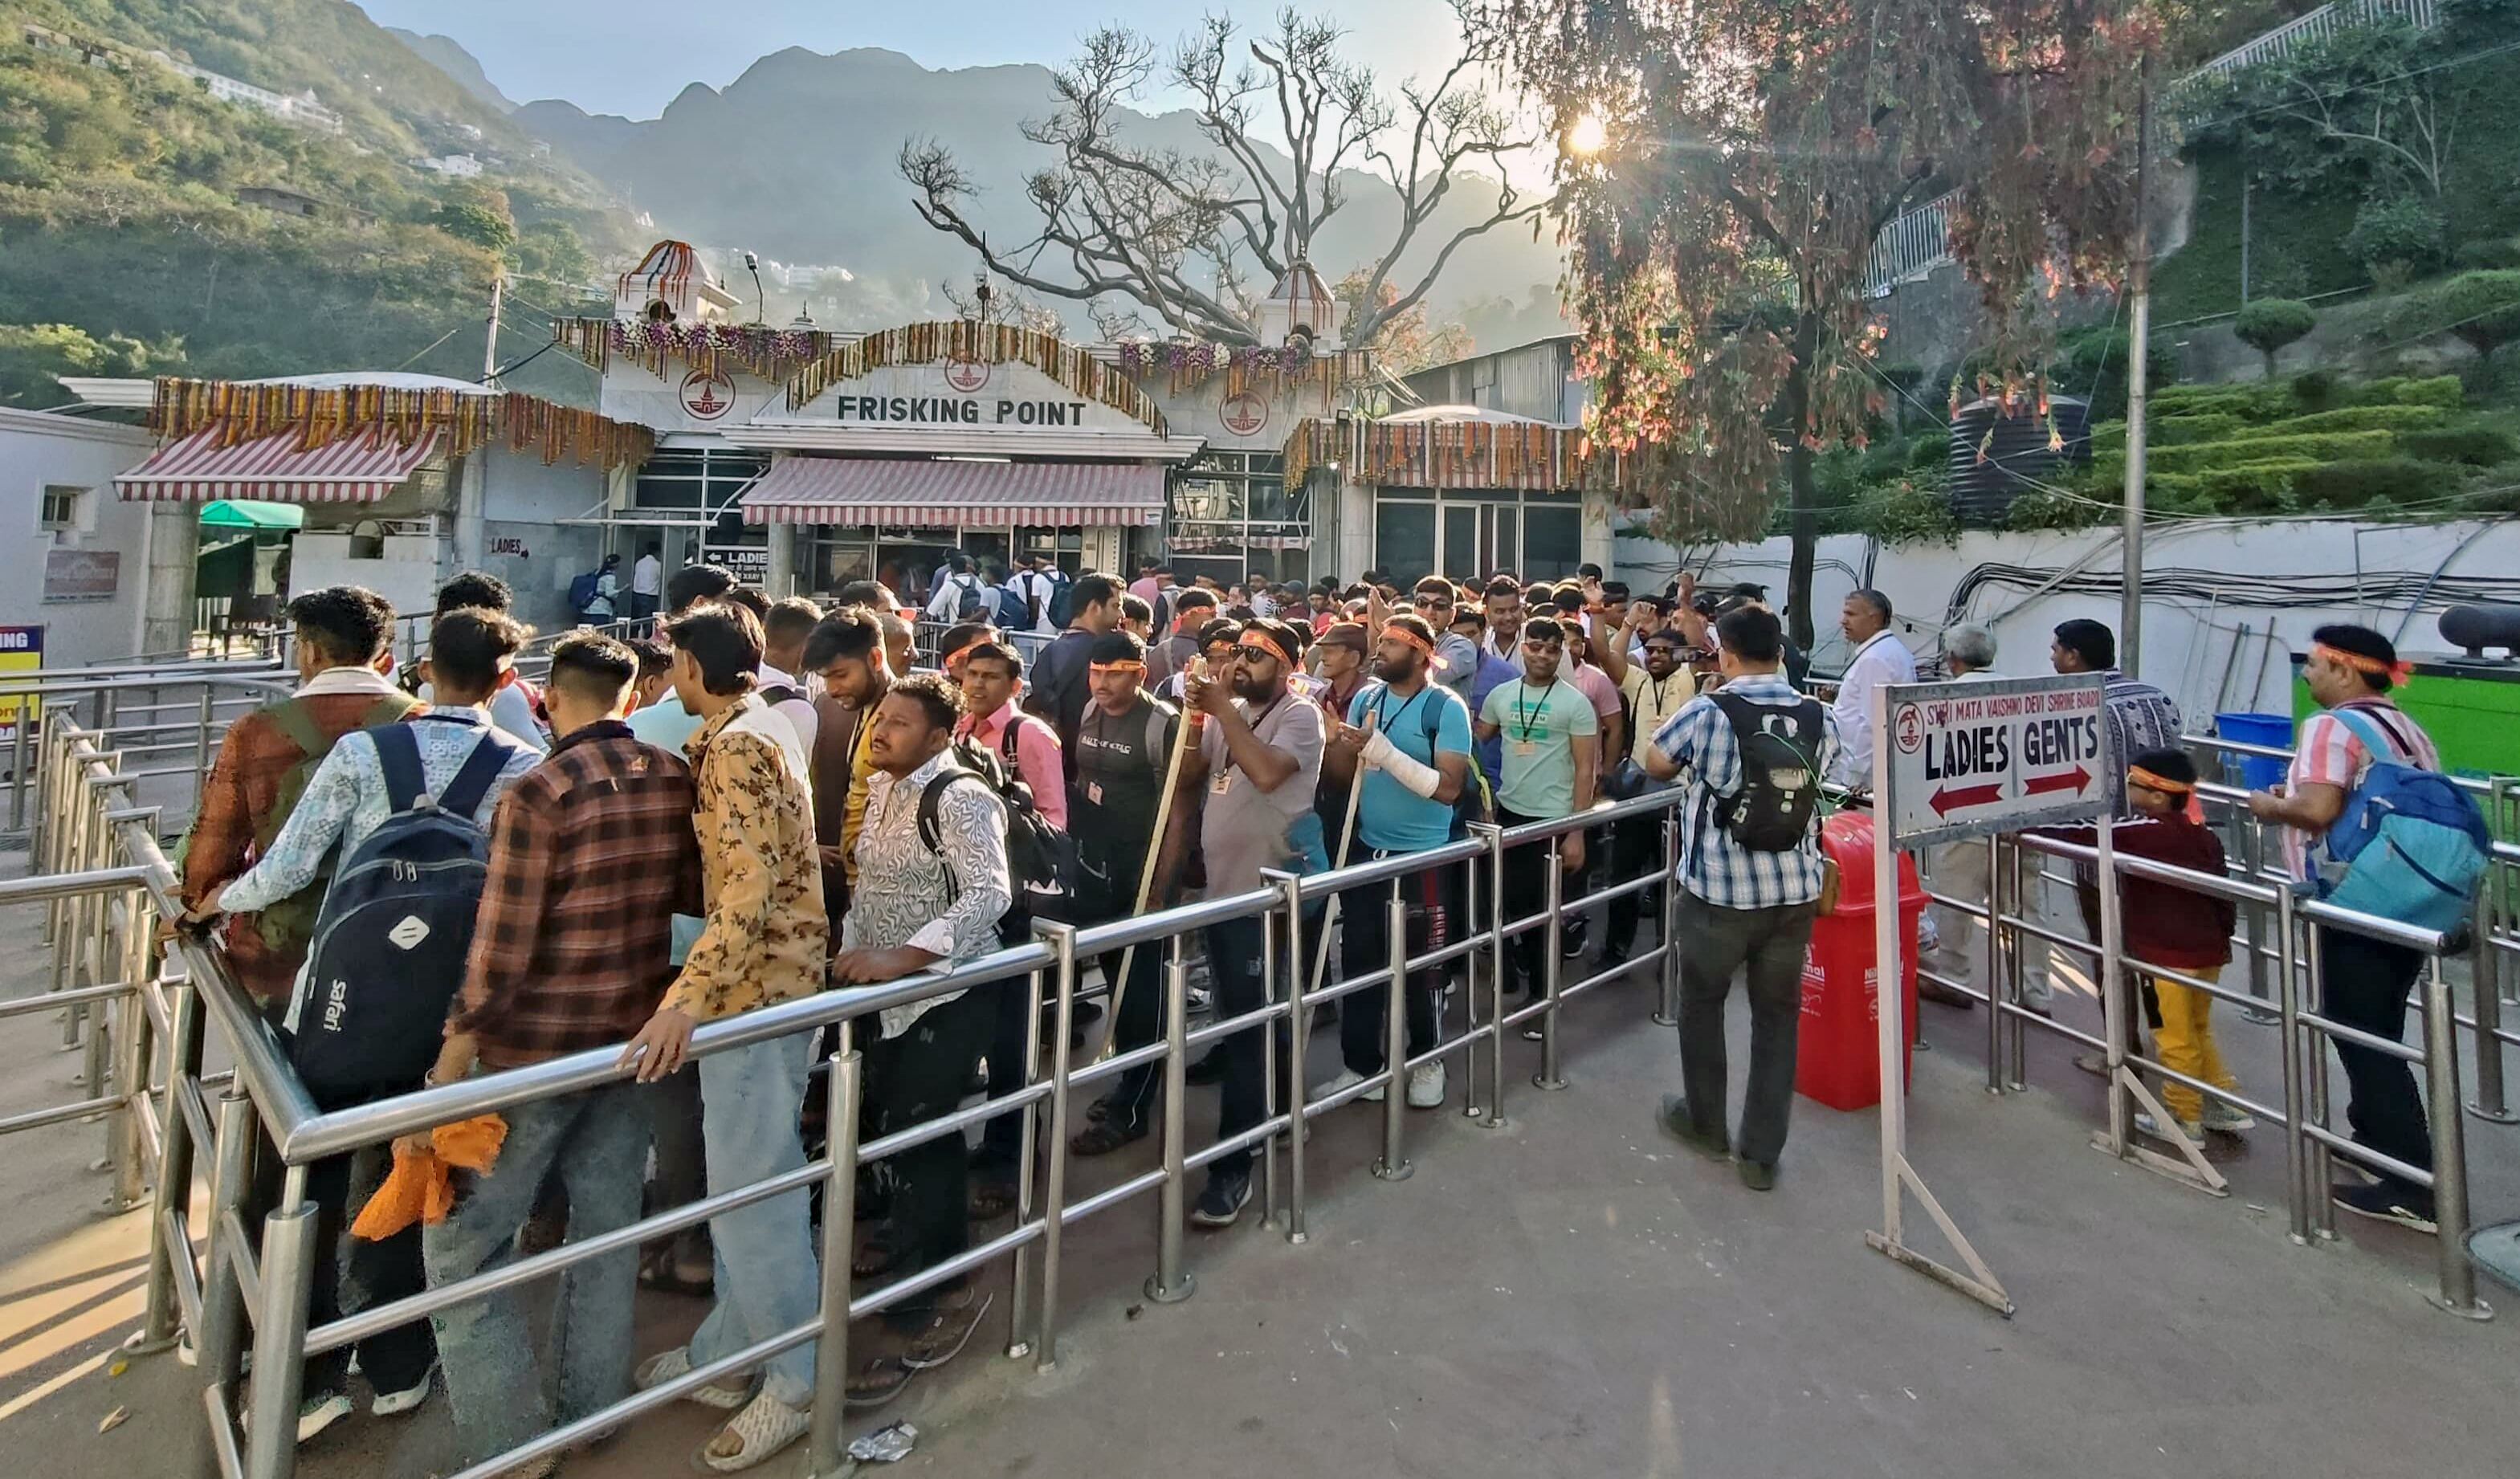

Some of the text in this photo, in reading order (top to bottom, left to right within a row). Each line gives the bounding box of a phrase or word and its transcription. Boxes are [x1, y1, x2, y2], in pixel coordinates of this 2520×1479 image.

[838, 396, 1087, 426] FRISKING POINT
[491, 537, 521, 554] LADIES
[728, 552, 768, 563] LADIE
[0, 632, 29, 648] ING
[1510, 713, 1547, 722] FREDOM
[1956, 701, 1983, 722] MATA
[1986, 698, 2022, 718] VAISHNO
[2025, 695, 2045, 714] DEVI
[2049, 692, 2076, 712] SHRINE
[2078, 690, 2100, 709] BOARD
[1925, 715, 2098, 780] LADIES GENTS
[323, 979, 347, 1032] safari
